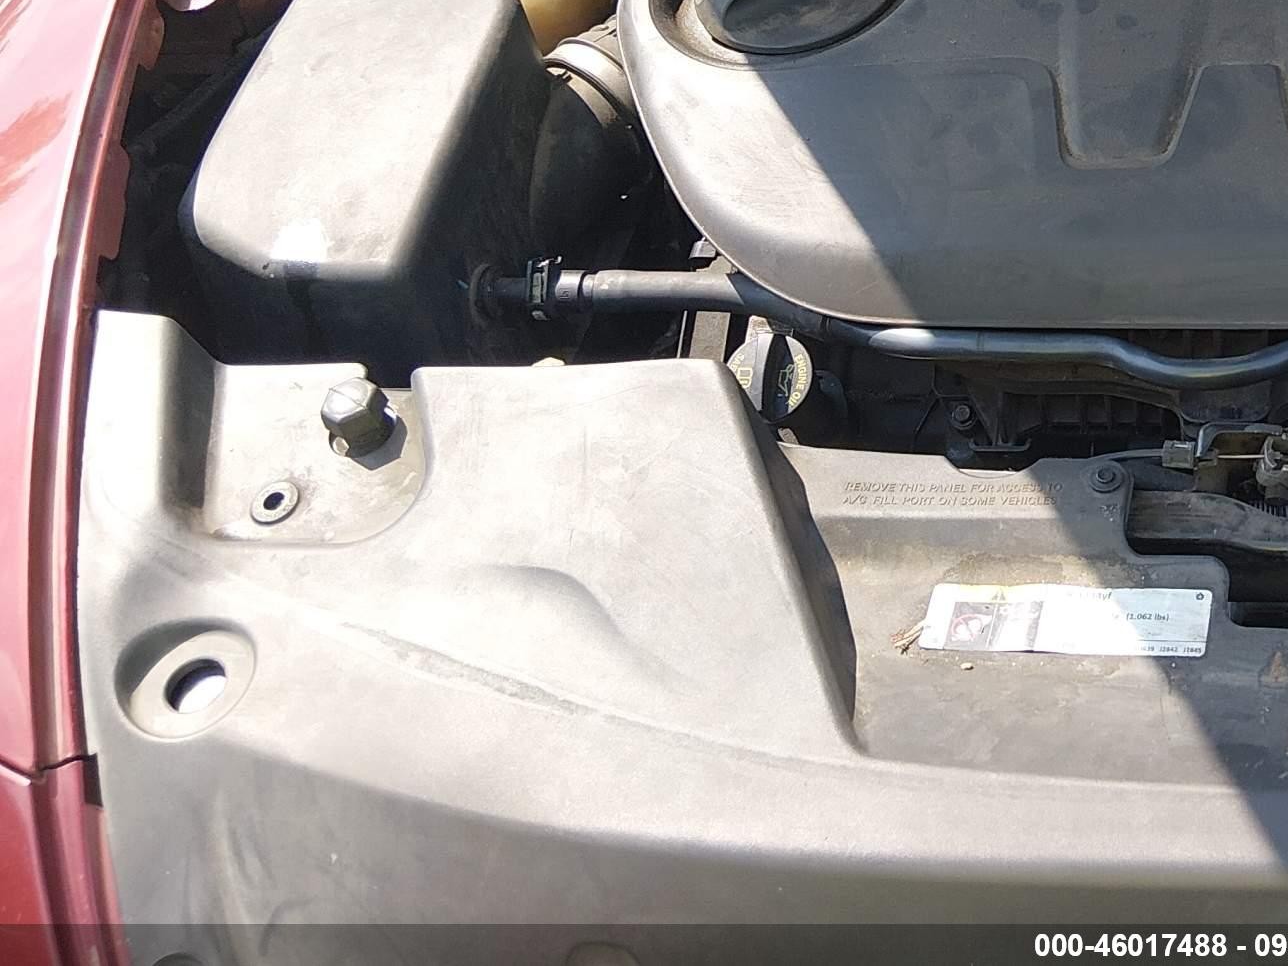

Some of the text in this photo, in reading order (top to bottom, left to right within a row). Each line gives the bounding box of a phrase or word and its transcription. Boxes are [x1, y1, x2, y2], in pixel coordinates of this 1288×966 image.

[794, 354, 808, 390] ENGINE
[844, 481, 1063, 494] REMOVE THIS PANEL FOR ACCESS TO
[842, 493, 1058, 507] A/C FILL PORT ON SOME VEHICLES
[1126, 612, 1170, 622] (1.062 lbs)
